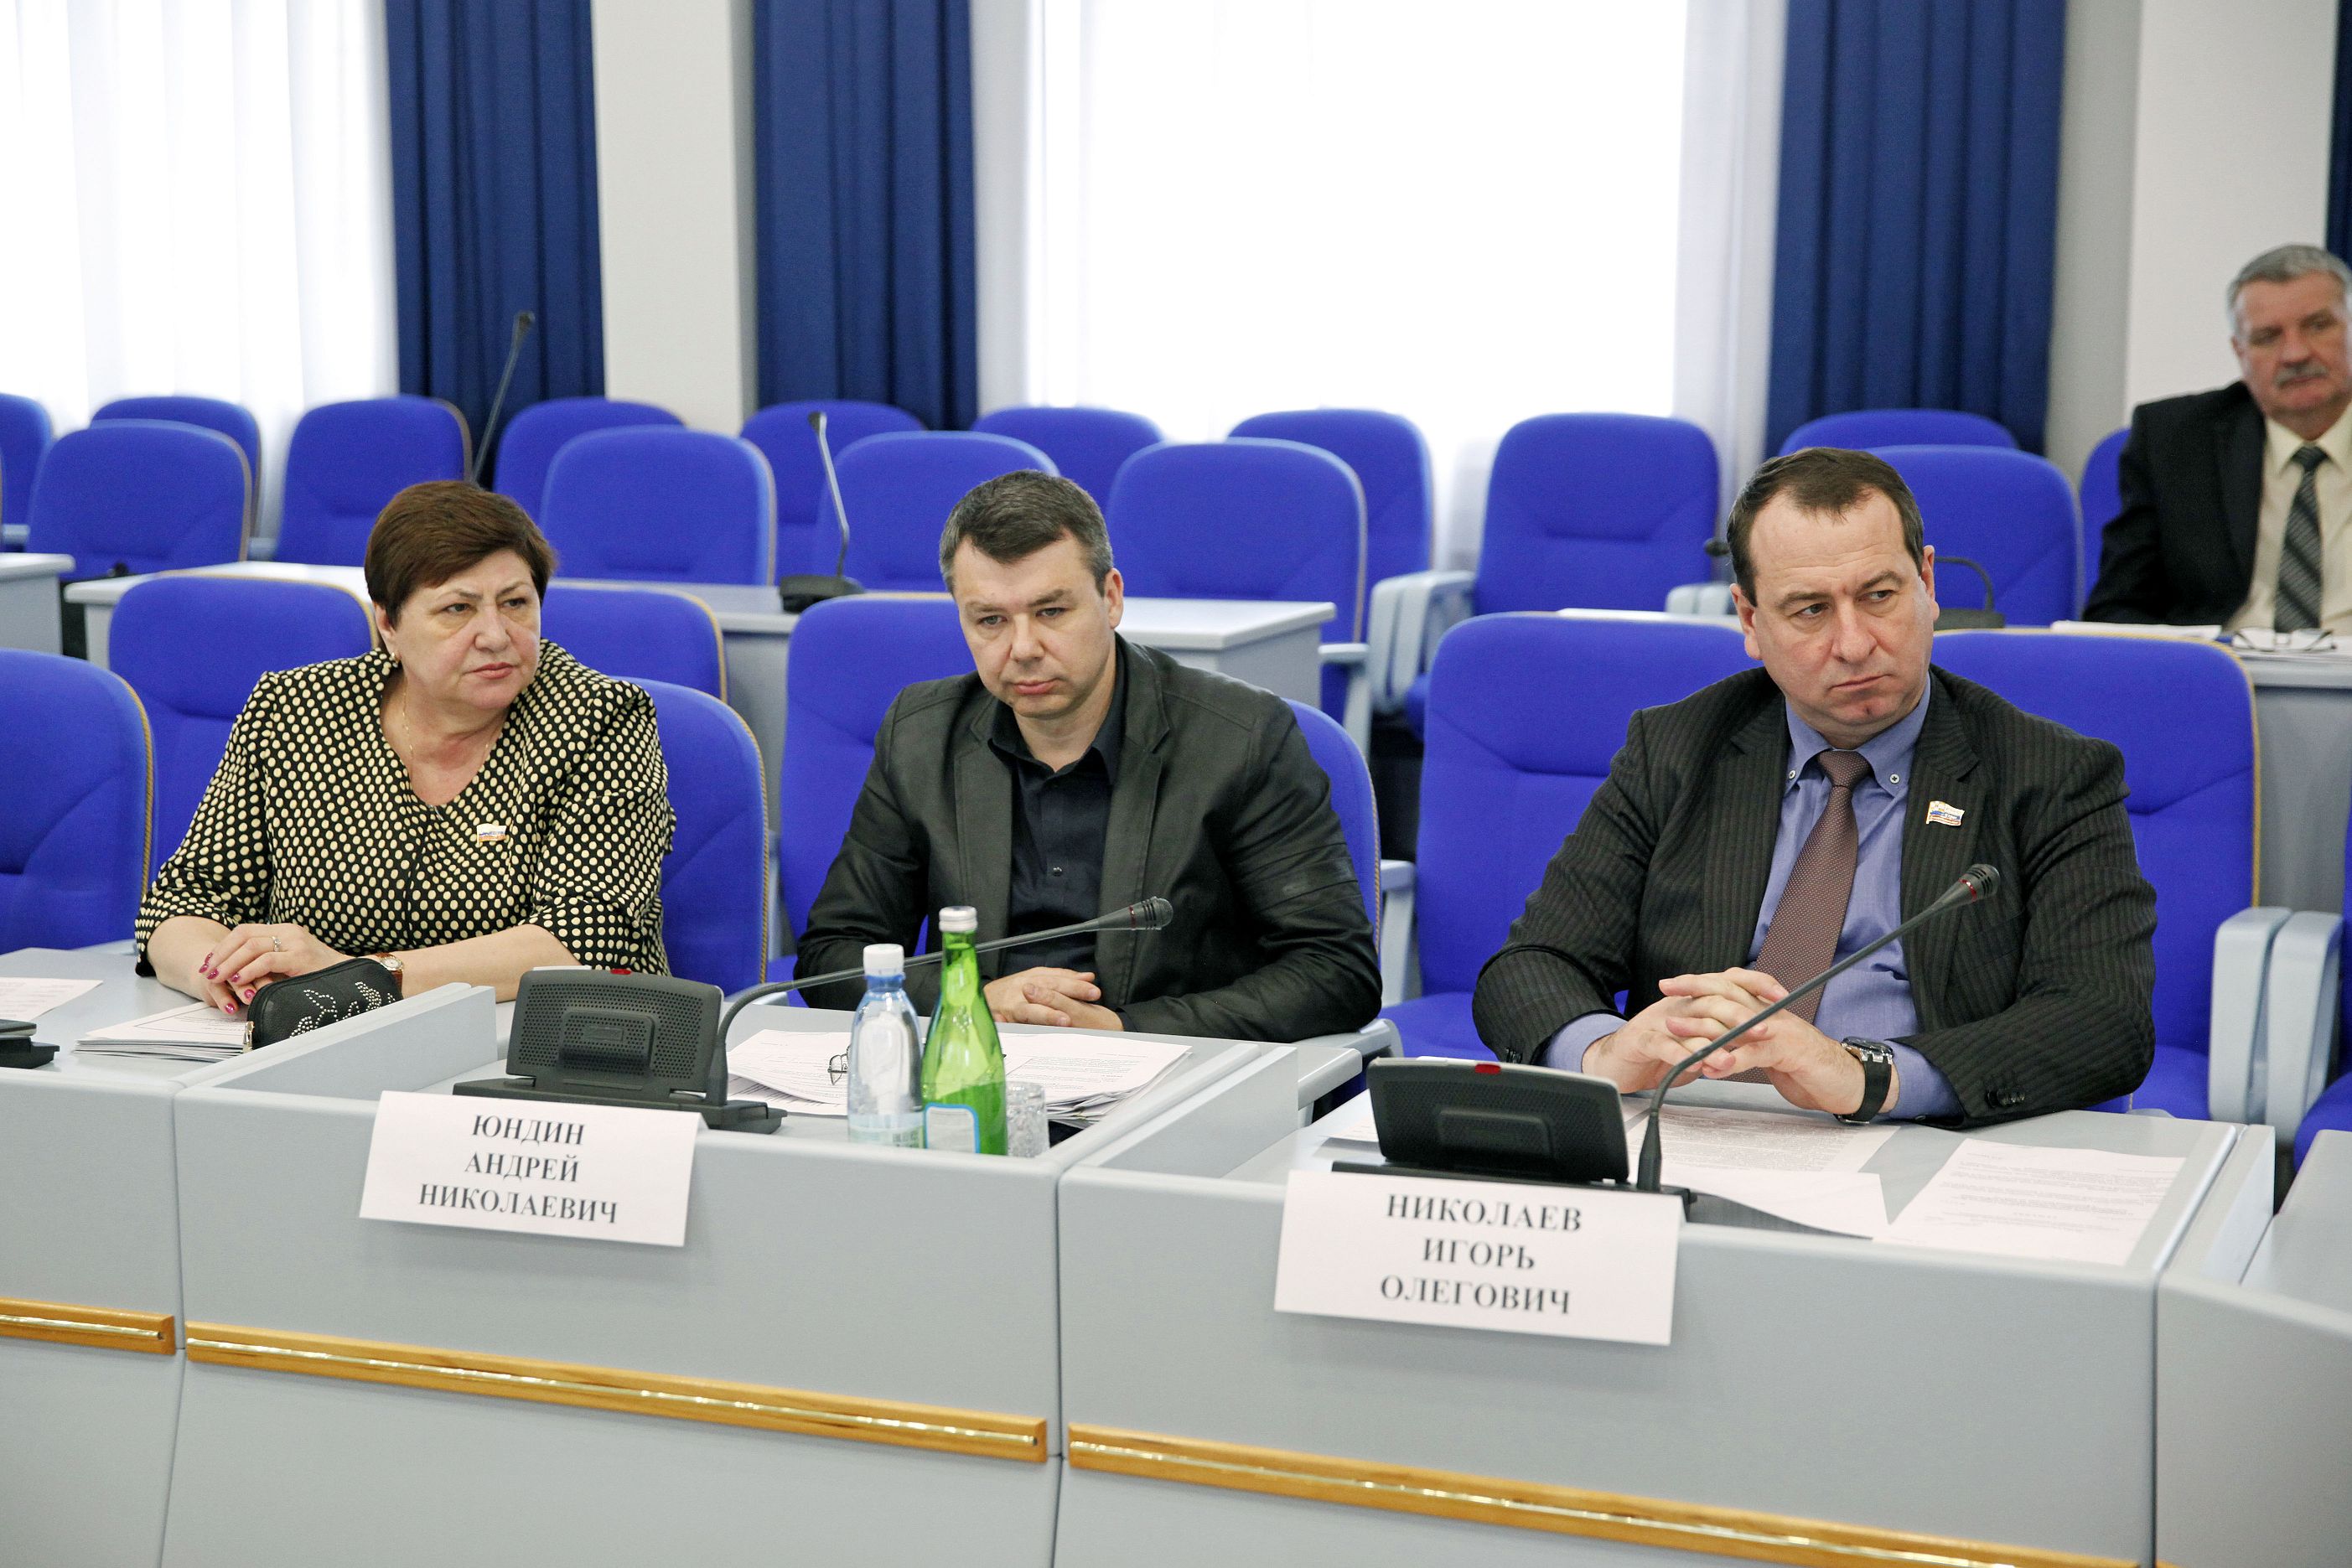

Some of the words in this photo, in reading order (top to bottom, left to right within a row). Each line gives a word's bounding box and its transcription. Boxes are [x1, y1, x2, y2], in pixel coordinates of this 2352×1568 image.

[471, 1114, 586, 1146] ЮНДИН
[464, 1151, 579, 1183] АНДРЕЙ
[417, 1182, 619, 1224] НИКОЛАЕВИЧ
[1386, 1193, 1582, 1232] НИКОЛАЕВ
[1422, 1237, 1536, 1270] ИГОРЬ
[1380, 1275, 1571, 1315] ОЛЕГОВИЧ
